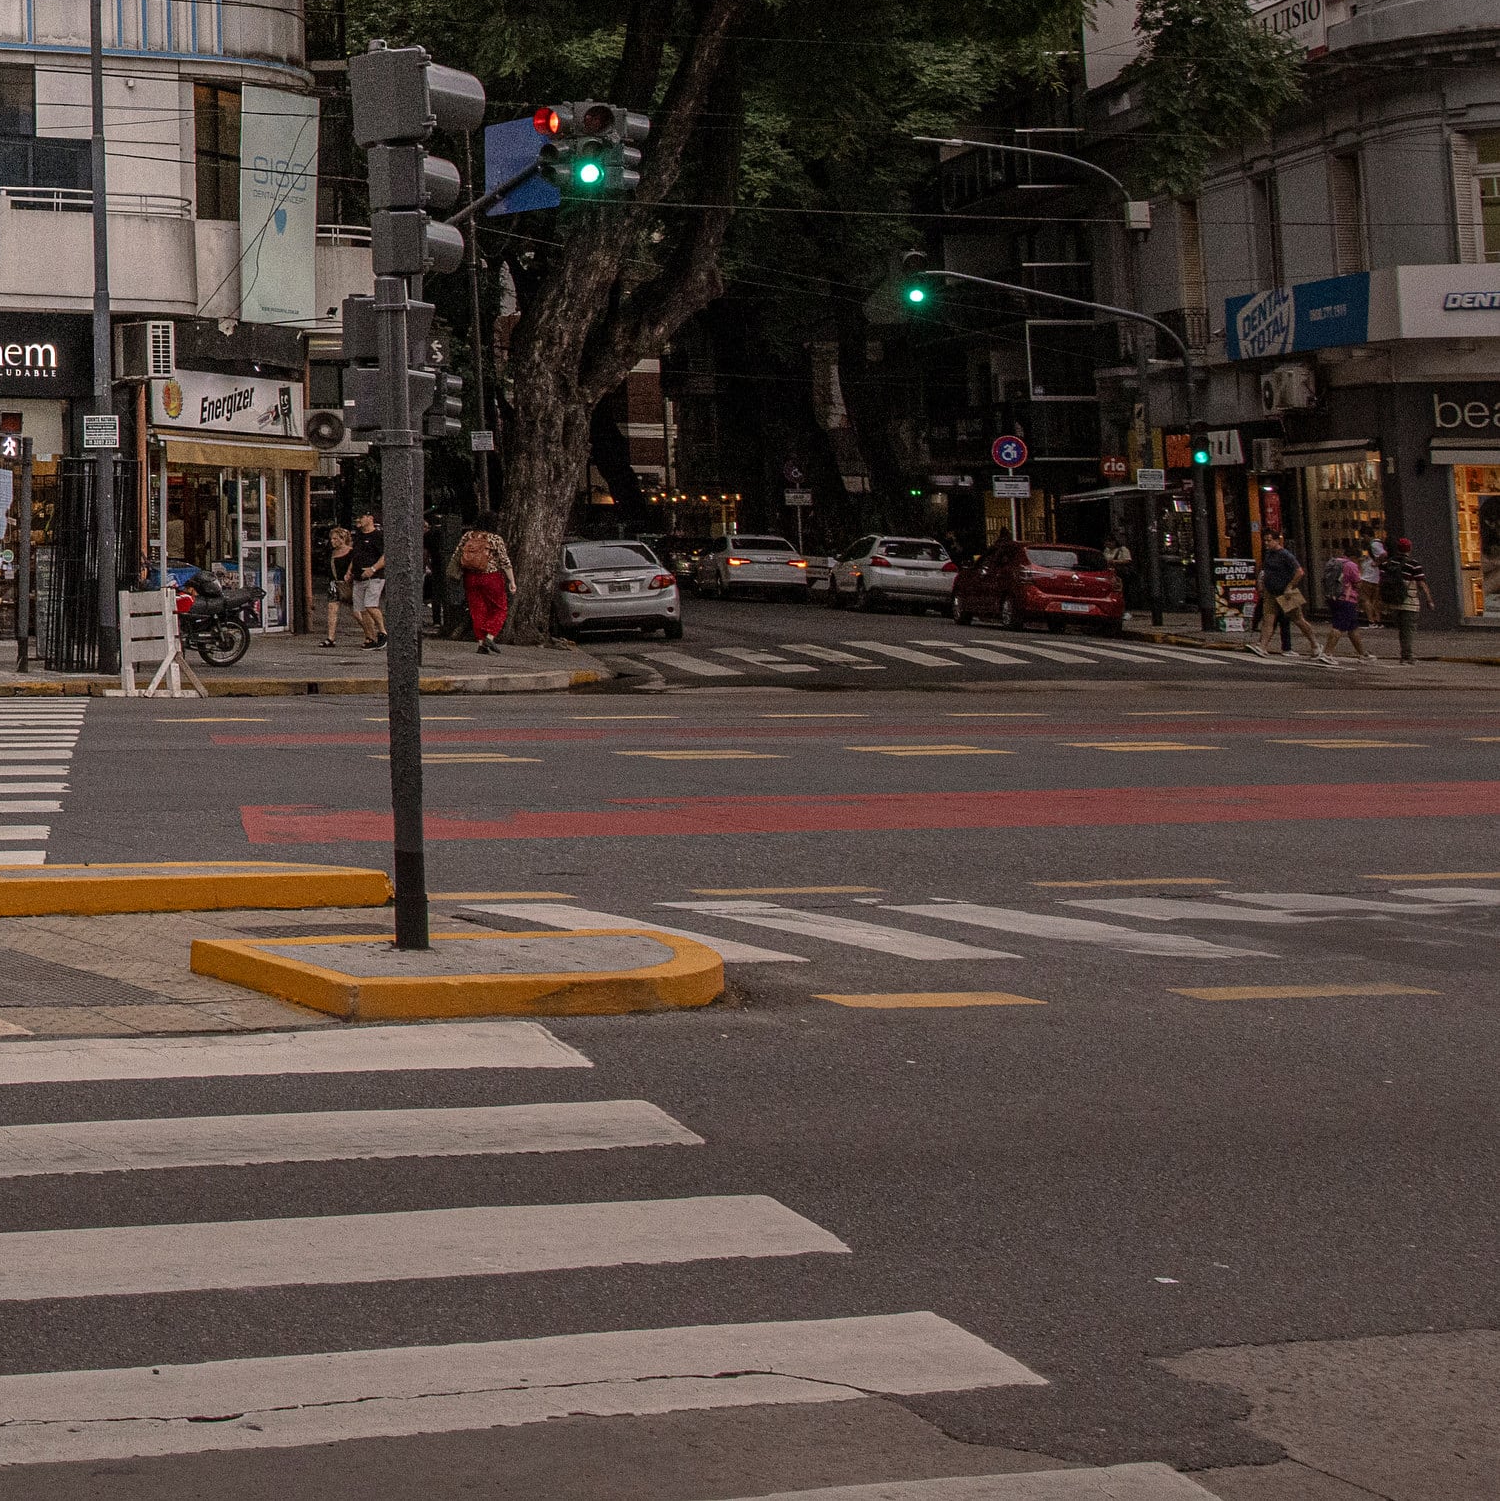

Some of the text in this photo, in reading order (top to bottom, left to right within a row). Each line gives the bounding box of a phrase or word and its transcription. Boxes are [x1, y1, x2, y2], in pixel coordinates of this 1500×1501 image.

[253, 155, 308, 192] SISO
[1243, 288, 1289, 340] DENTAL
[1251, 313, 1289, 357] TOTAL
[199, 386, 255, 425] Energizer
[1103, 457, 1126, 472] ria
[1214, 565, 1256, 575] GRANDE
